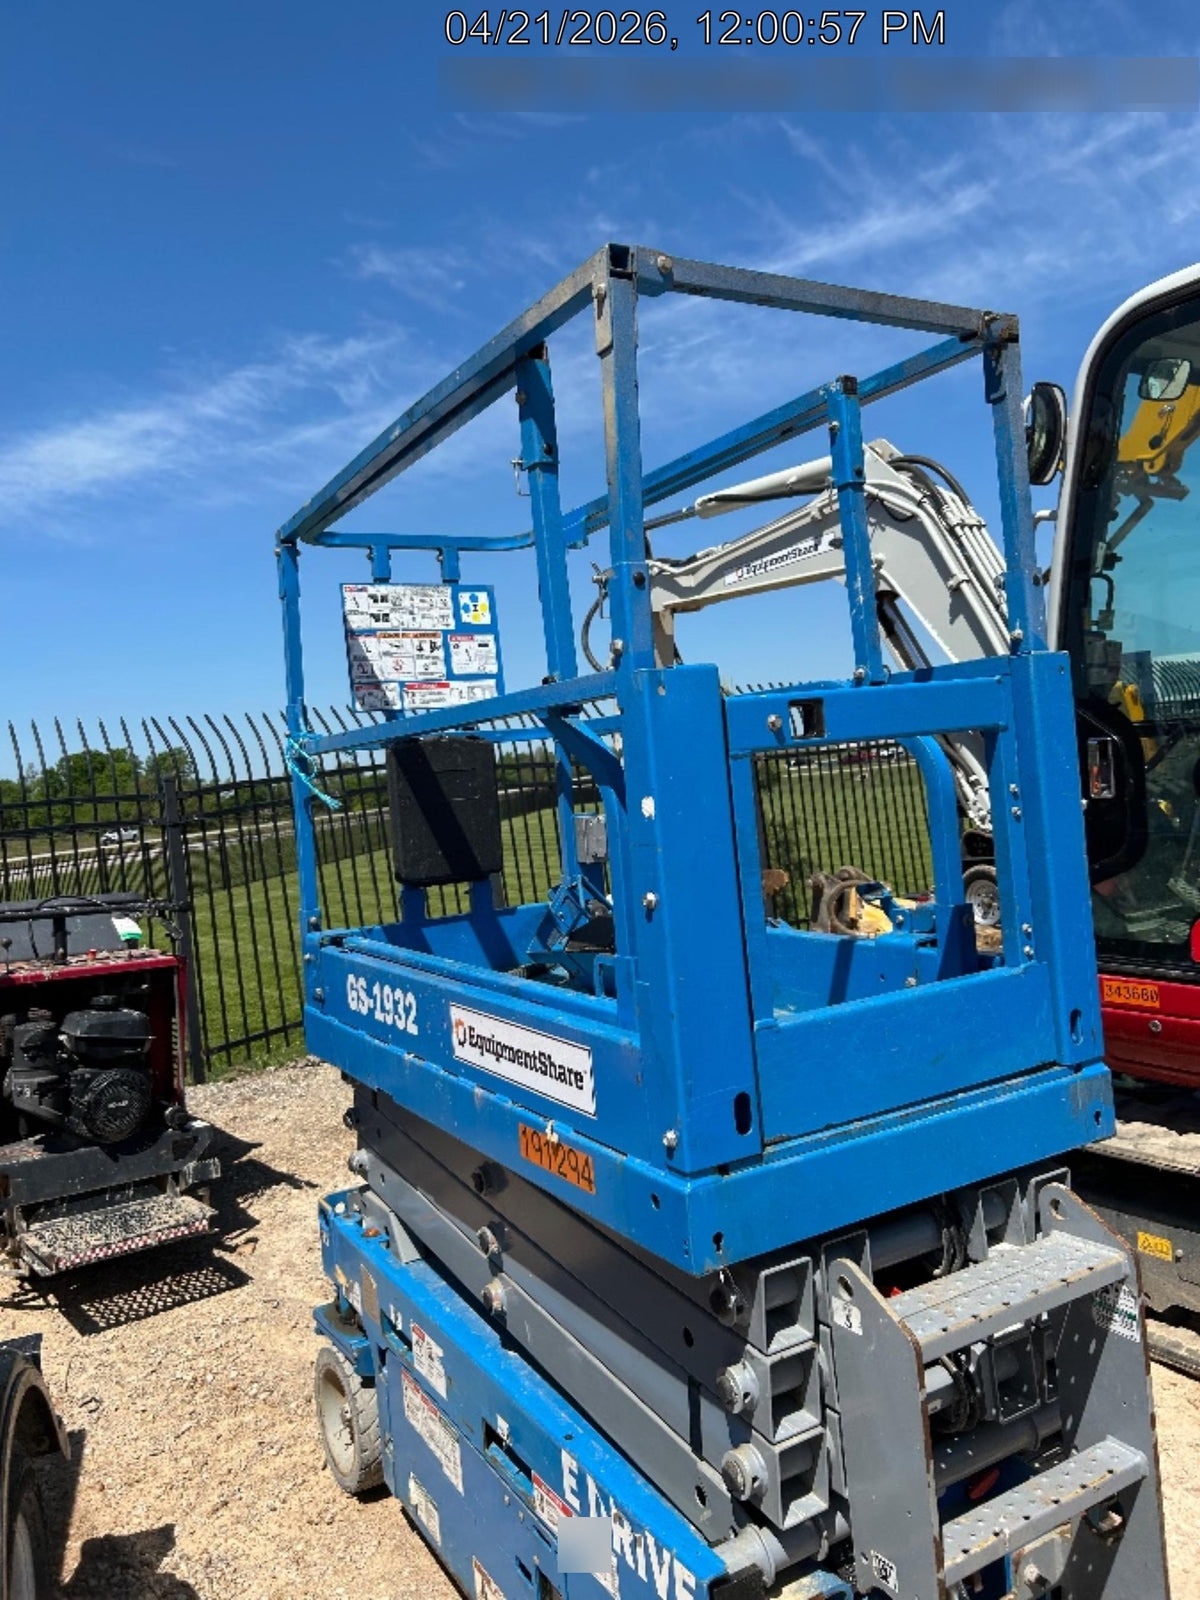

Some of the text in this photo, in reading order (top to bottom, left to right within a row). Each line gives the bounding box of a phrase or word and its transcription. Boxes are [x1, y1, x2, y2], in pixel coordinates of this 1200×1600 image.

[347, 973, 418, 1036] GS-1932
[469, 1025, 585, 1090] EquipmentShare
[522, 1126, 594, 1191] 191294
